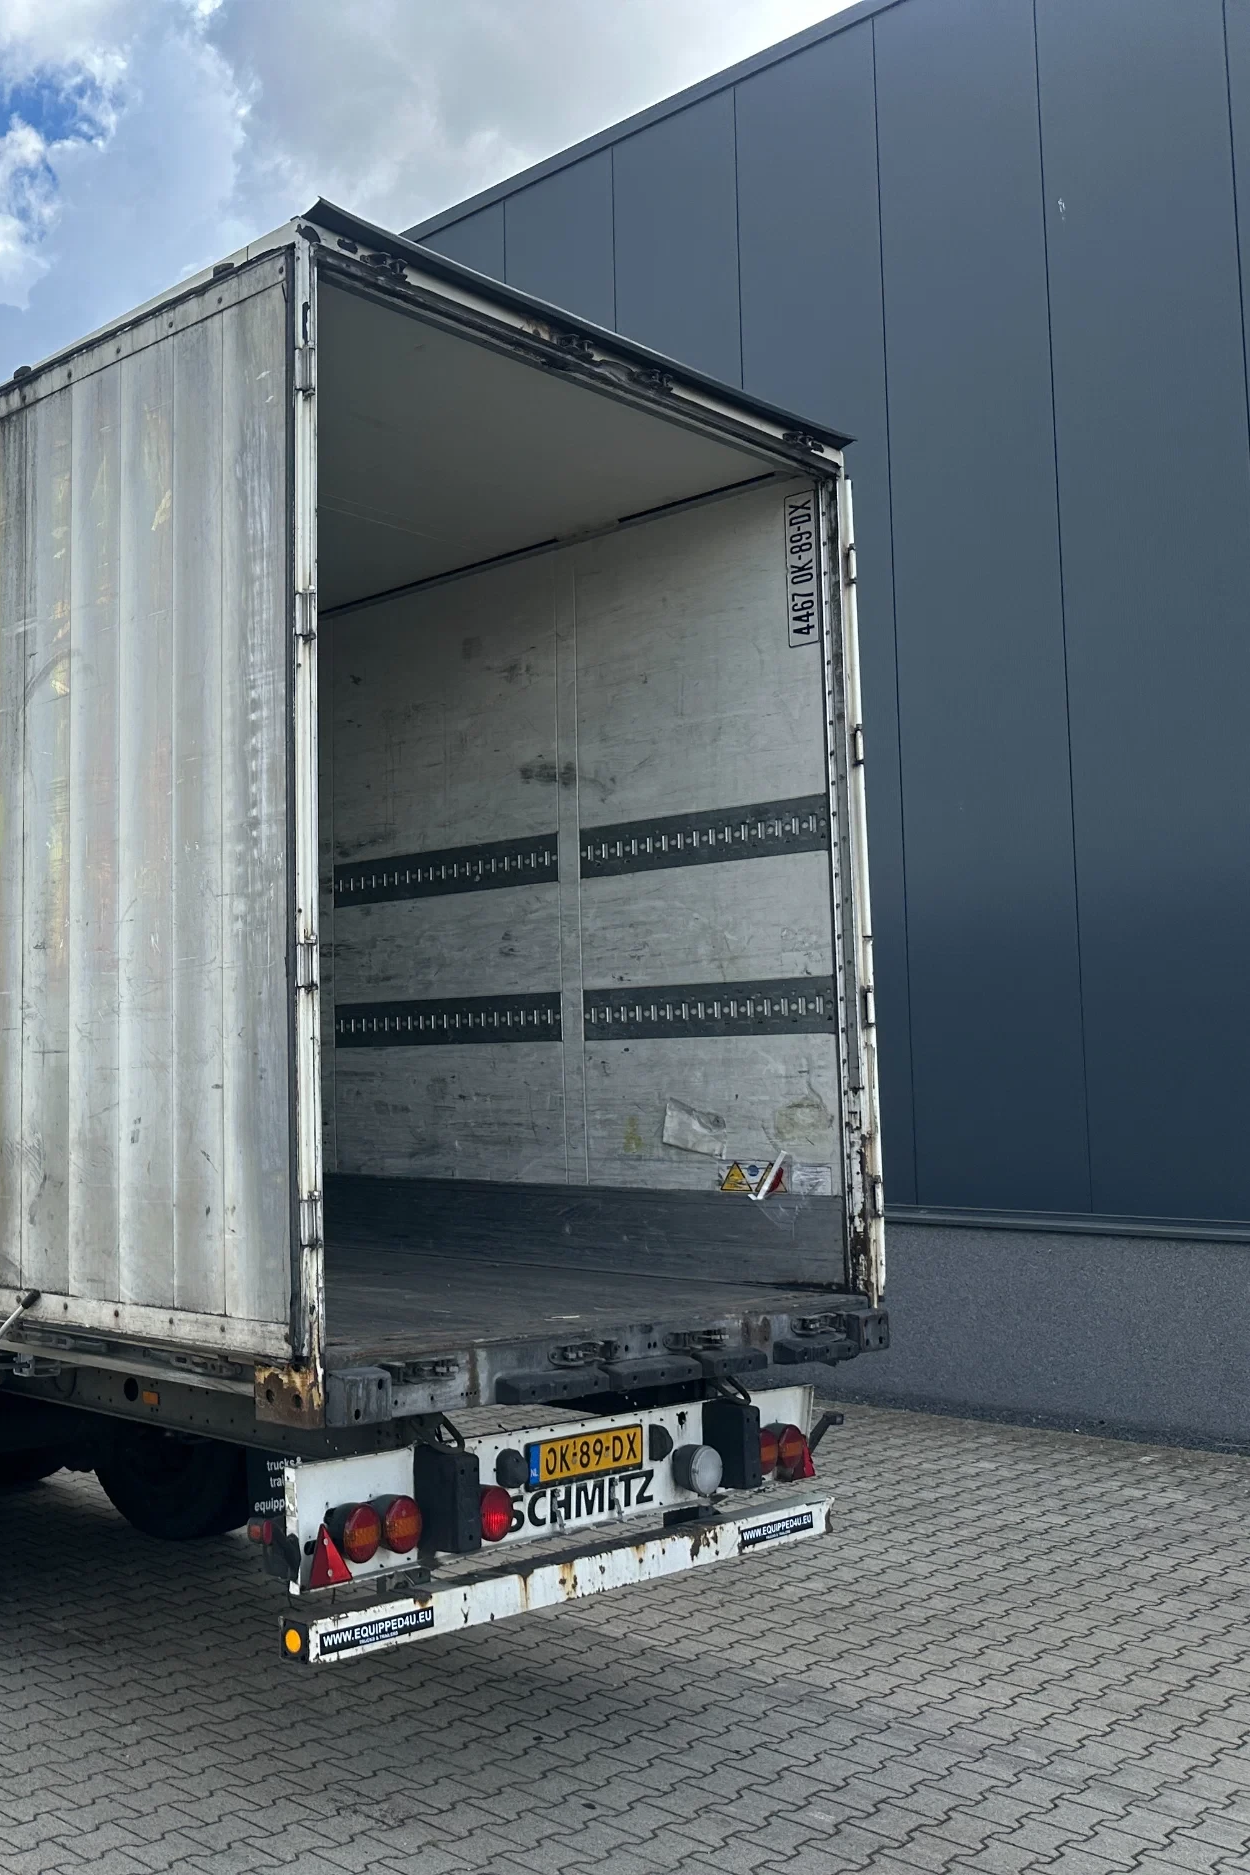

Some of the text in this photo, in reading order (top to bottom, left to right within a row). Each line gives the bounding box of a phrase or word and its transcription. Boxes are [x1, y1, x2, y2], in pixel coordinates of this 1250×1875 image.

[788, 499, 815, 635] 4467 OK-89-DX
[530, 1468, 539, 1477] NL
[545, 1432, 637, 1475] OK-89-DX
[508, 1469, 654, 1533] SCHMITZ
[742, 1514, 812, 1541] WWW.EQUIPPED4U.EU
[322, 1610, 432, 1647] WWW.EQUIPPED4U.EU
